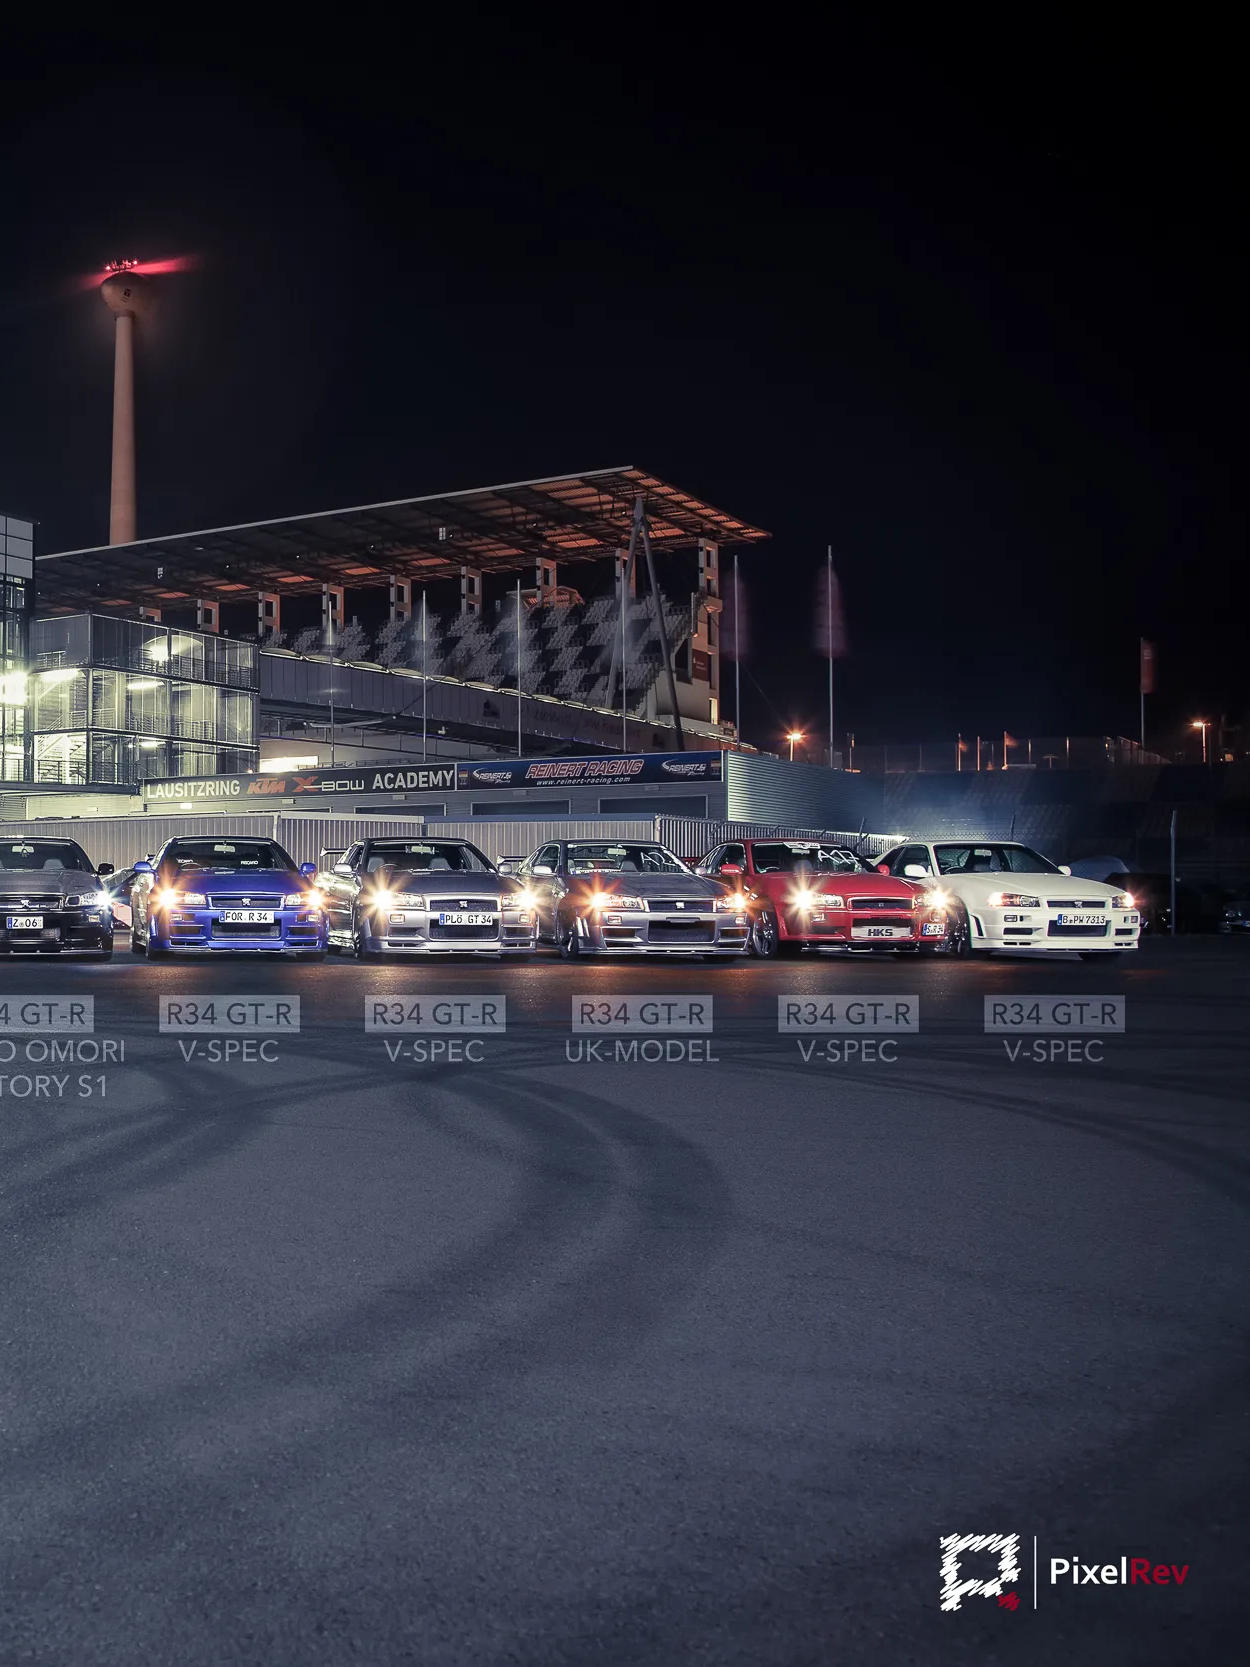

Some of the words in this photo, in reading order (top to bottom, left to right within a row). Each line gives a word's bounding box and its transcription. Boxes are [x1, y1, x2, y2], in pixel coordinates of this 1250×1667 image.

[525, 761, 588, 779] REINERT
[585, 759, 645, 776] RACING
[146, 780, 240, 799] LAUSITZRING
[247, 778, 286, 795] KTM
[372, 770, 454, 790] ACADEMY
[536, 777, 631, 786] www.reinert-racing.com
[225, 911, 243, 921] FOR
[248, 912, 255, 921] R
[256, 912, 268, 922] 34
[467, 914, 479, 924] GT
[480, 914, 492, 924] 34
[1062, 915, 1069, 924] B
[12, 918, 19, 928] Z
[24, 918, 38, 928] 06
[867, 928, 893, 936] HKS
